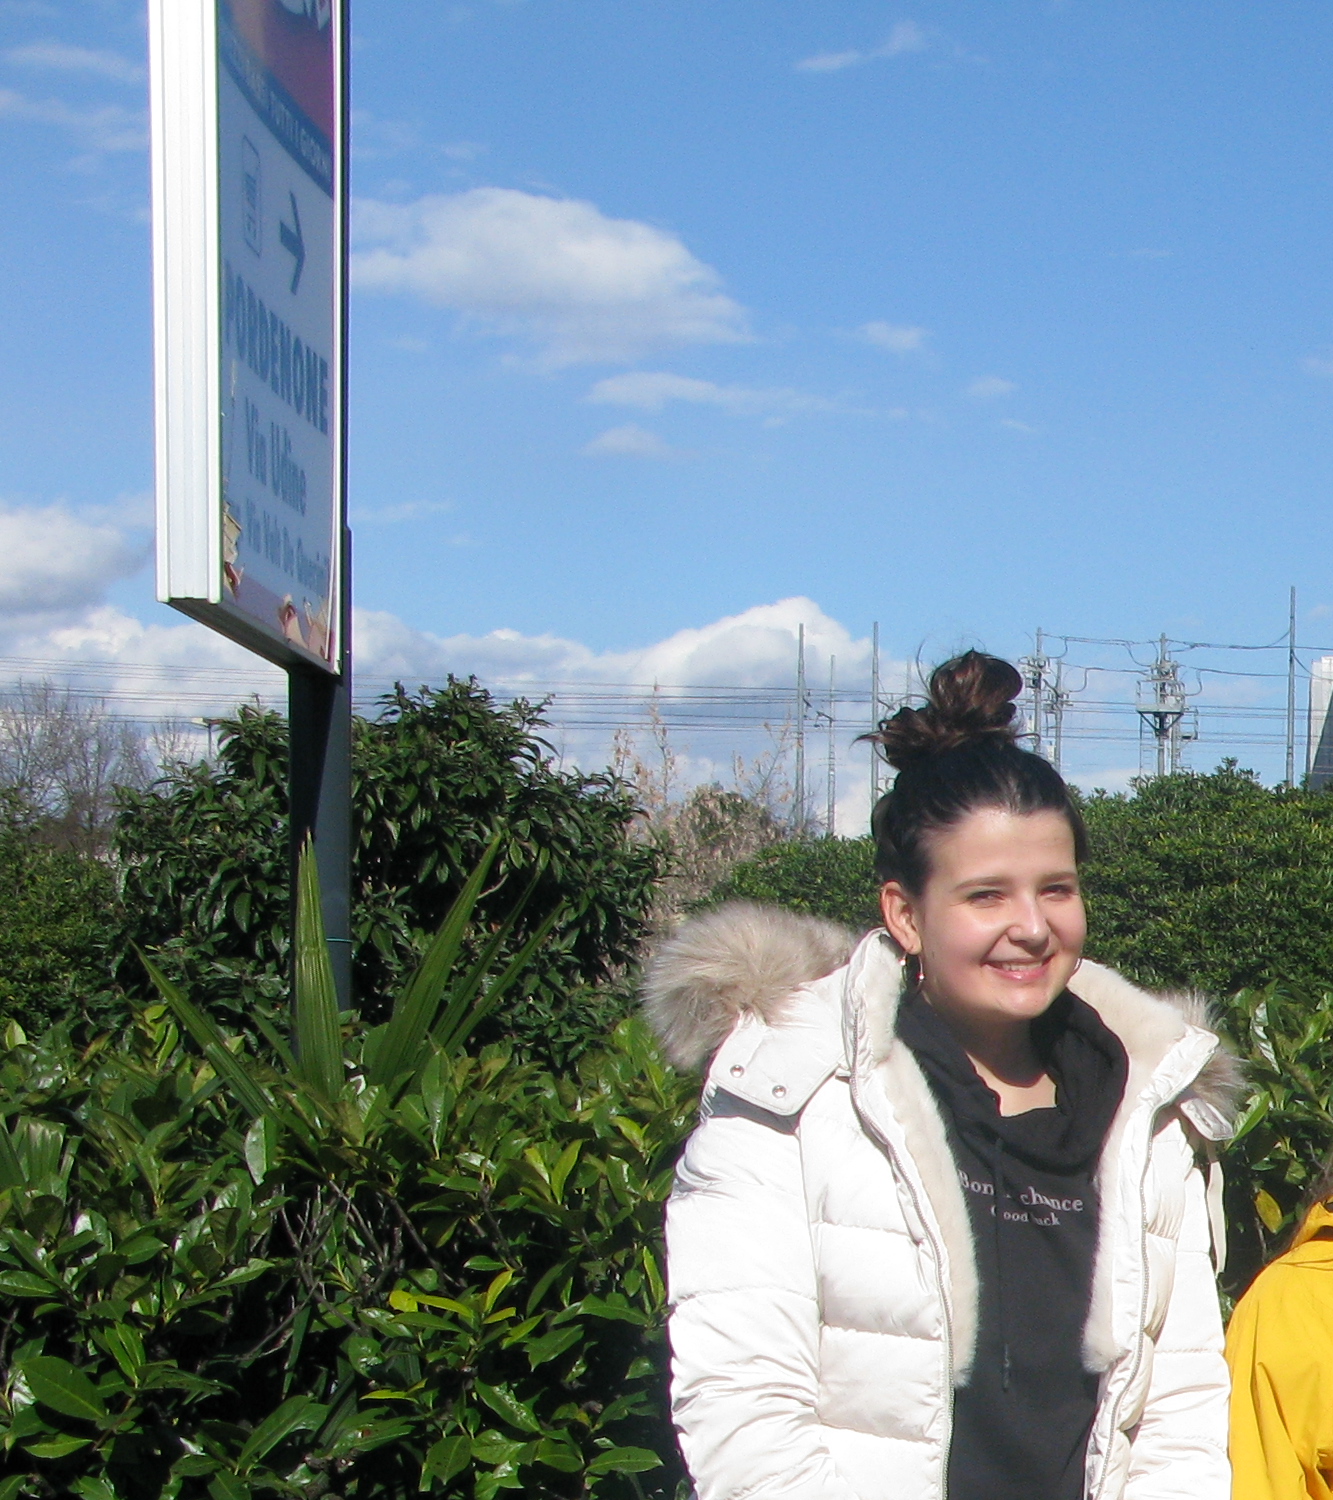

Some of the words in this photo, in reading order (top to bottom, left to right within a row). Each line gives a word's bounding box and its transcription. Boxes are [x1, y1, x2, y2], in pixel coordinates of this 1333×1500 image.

[225, 260, 328, 437] PORDENONE
[245, 397, 267, 486] Via
[1031, 1211, 1061, 1227] uck
